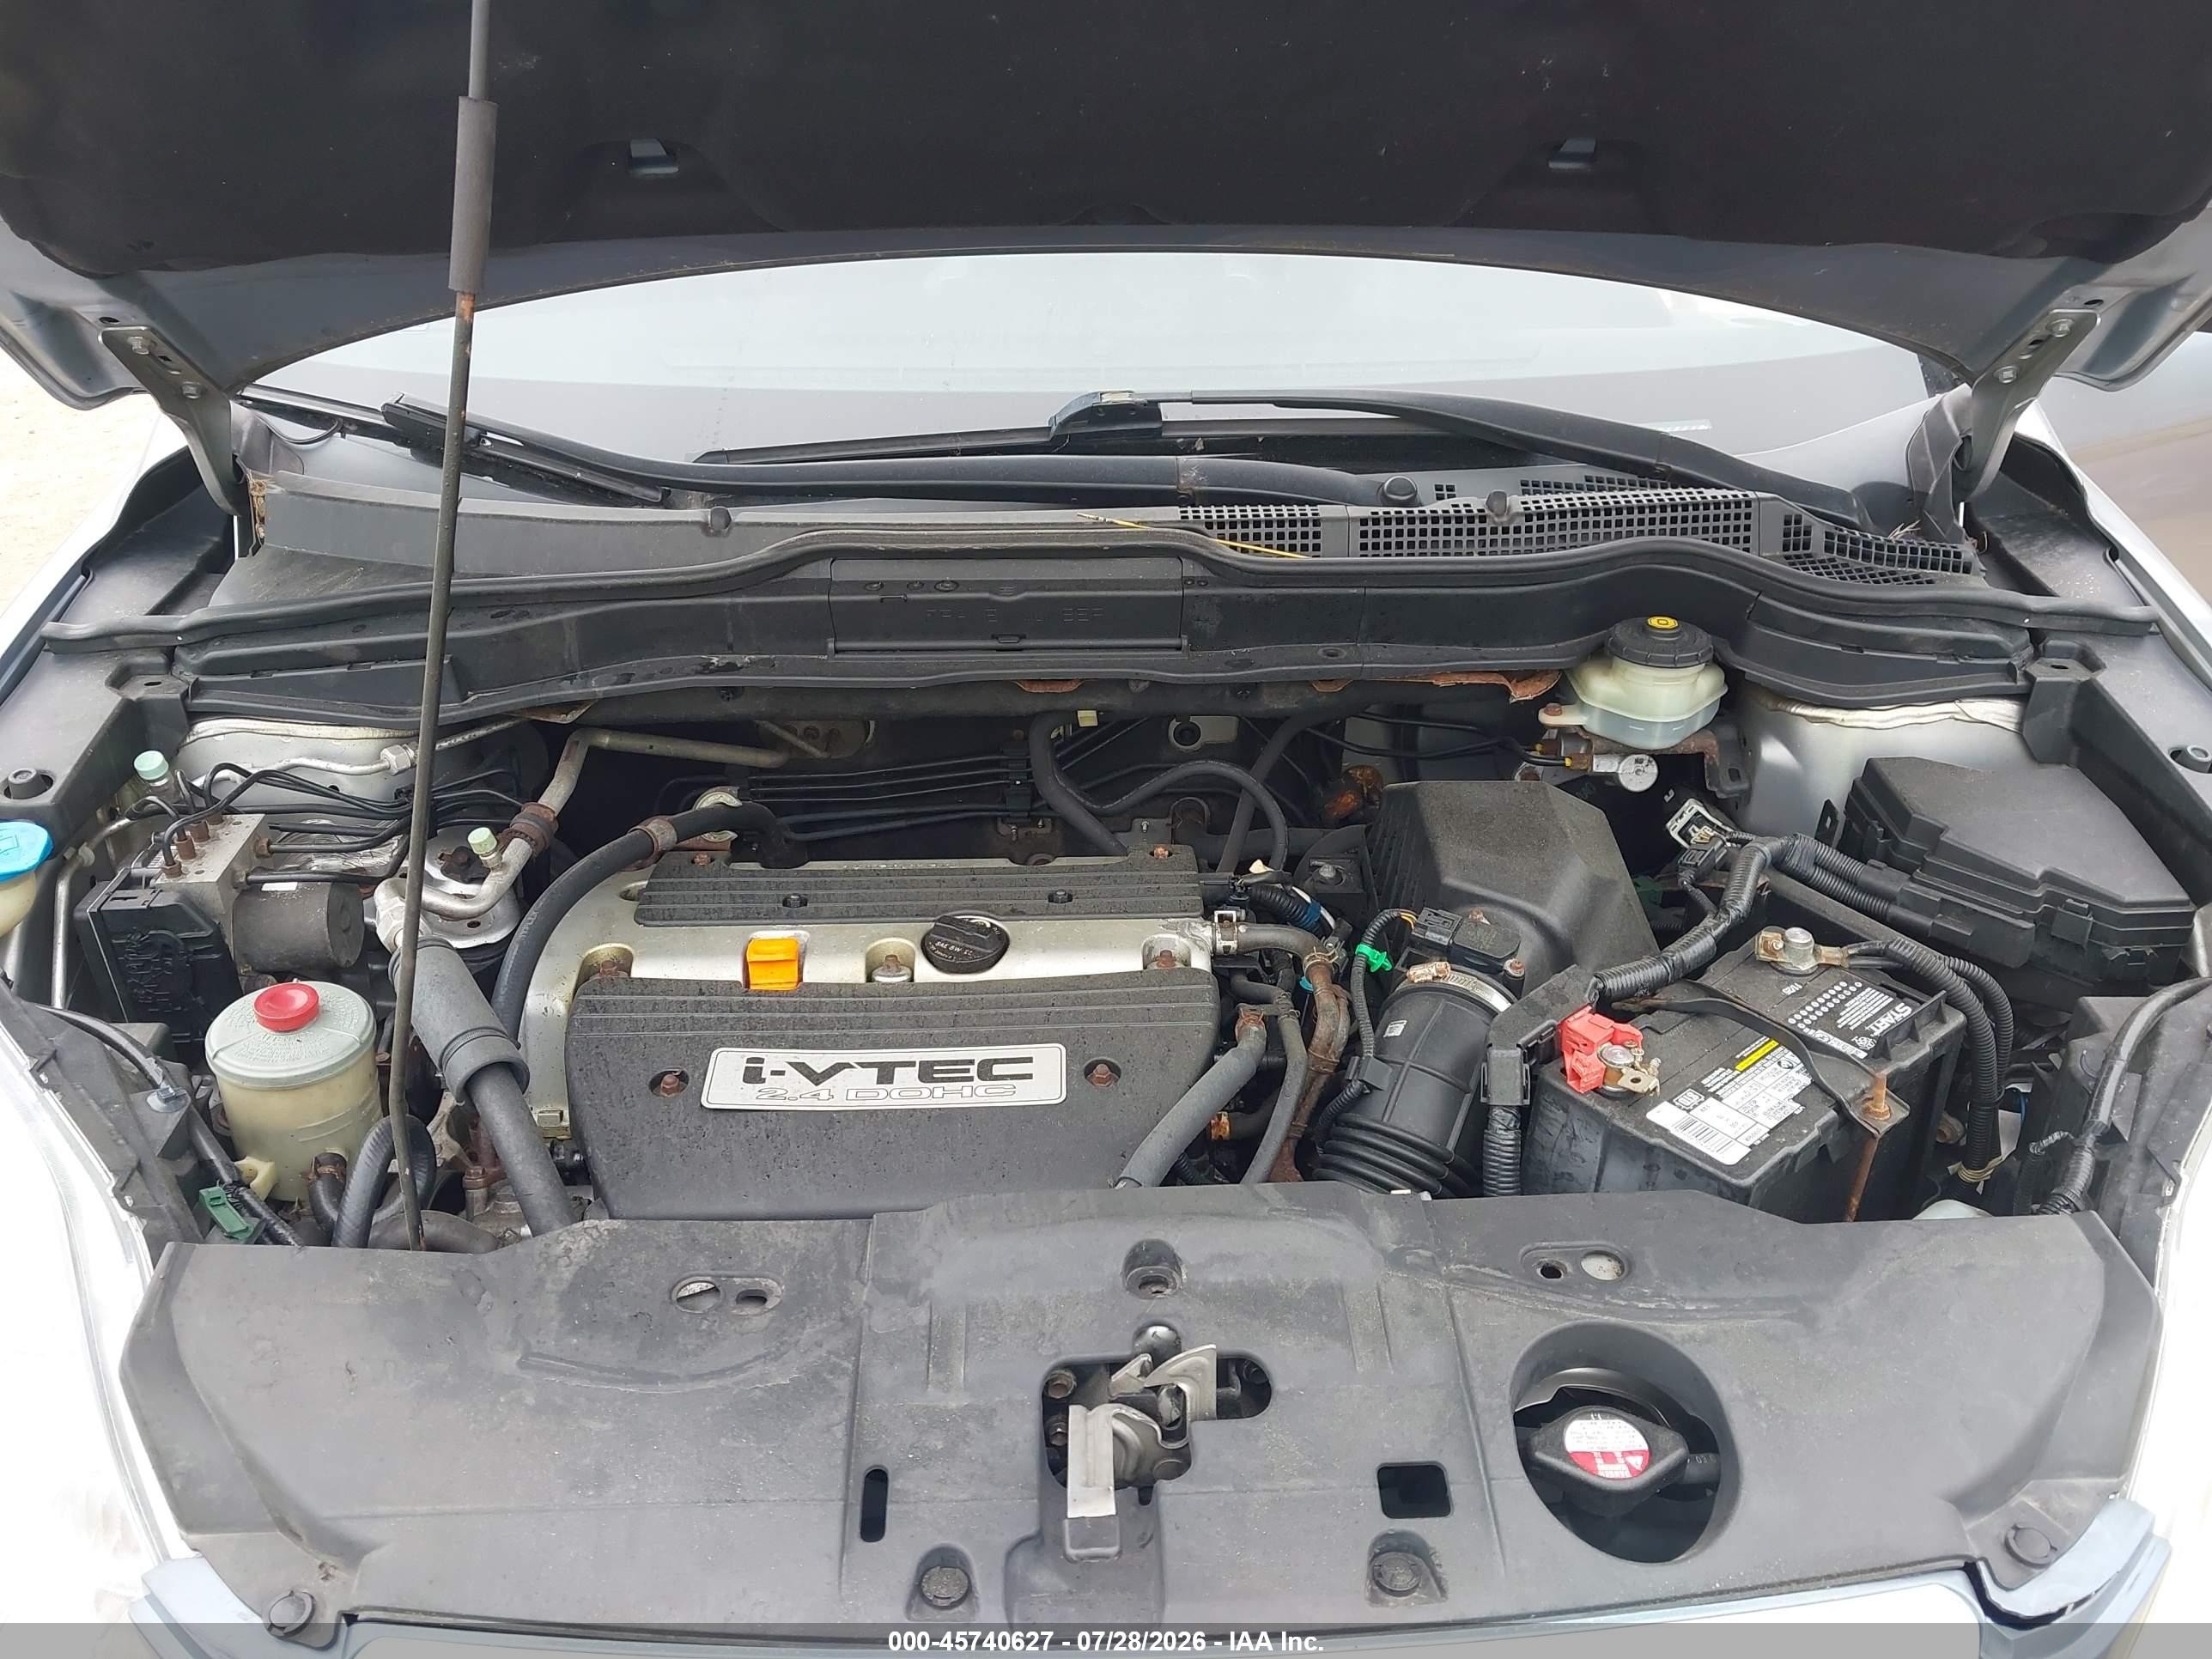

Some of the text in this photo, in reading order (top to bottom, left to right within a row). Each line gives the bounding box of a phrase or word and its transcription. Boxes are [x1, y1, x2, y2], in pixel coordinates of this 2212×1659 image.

[742, 1056, 1033, 1086] i-VTEC
[756, 1084, 1017, 1101] 2.4 DOHC
